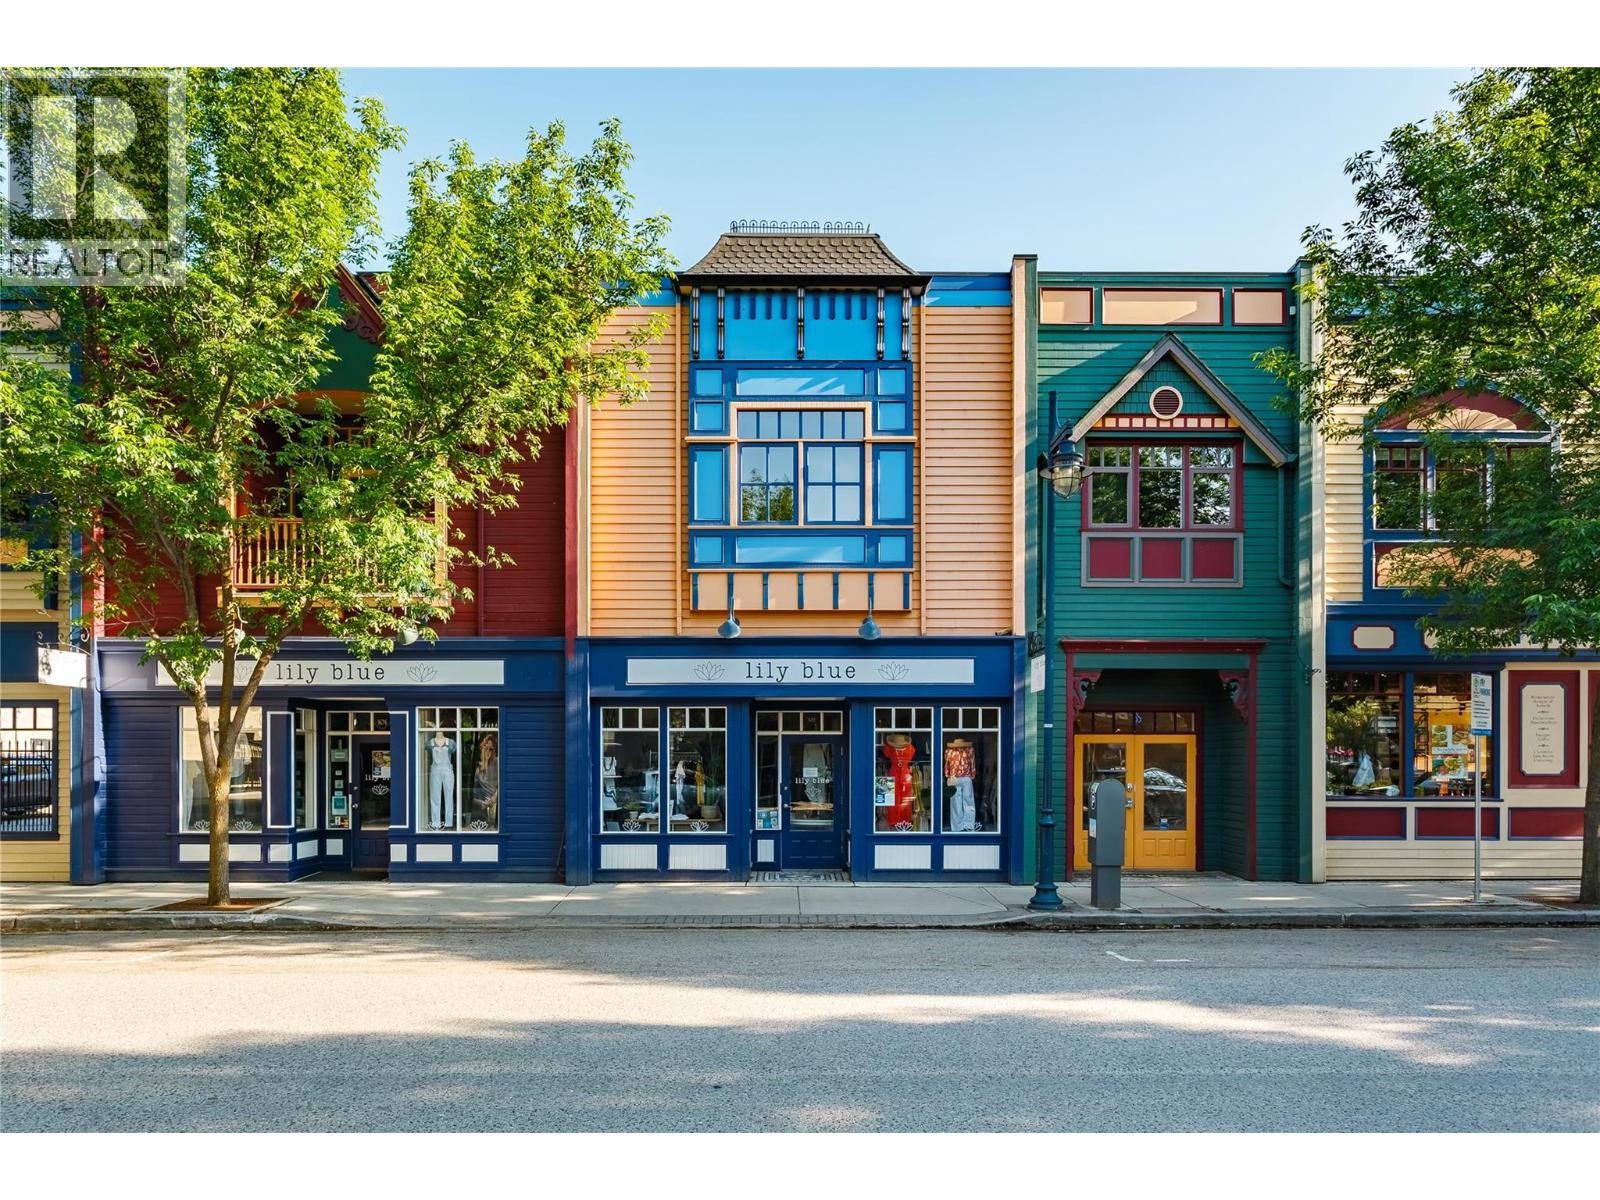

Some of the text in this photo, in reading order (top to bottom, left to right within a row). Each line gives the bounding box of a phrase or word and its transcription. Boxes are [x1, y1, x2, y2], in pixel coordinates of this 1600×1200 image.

[276, 663, 385, 684] lily blue
[746, 661, 856, 683] lily blue
[795, 777, 810, 785] lily
